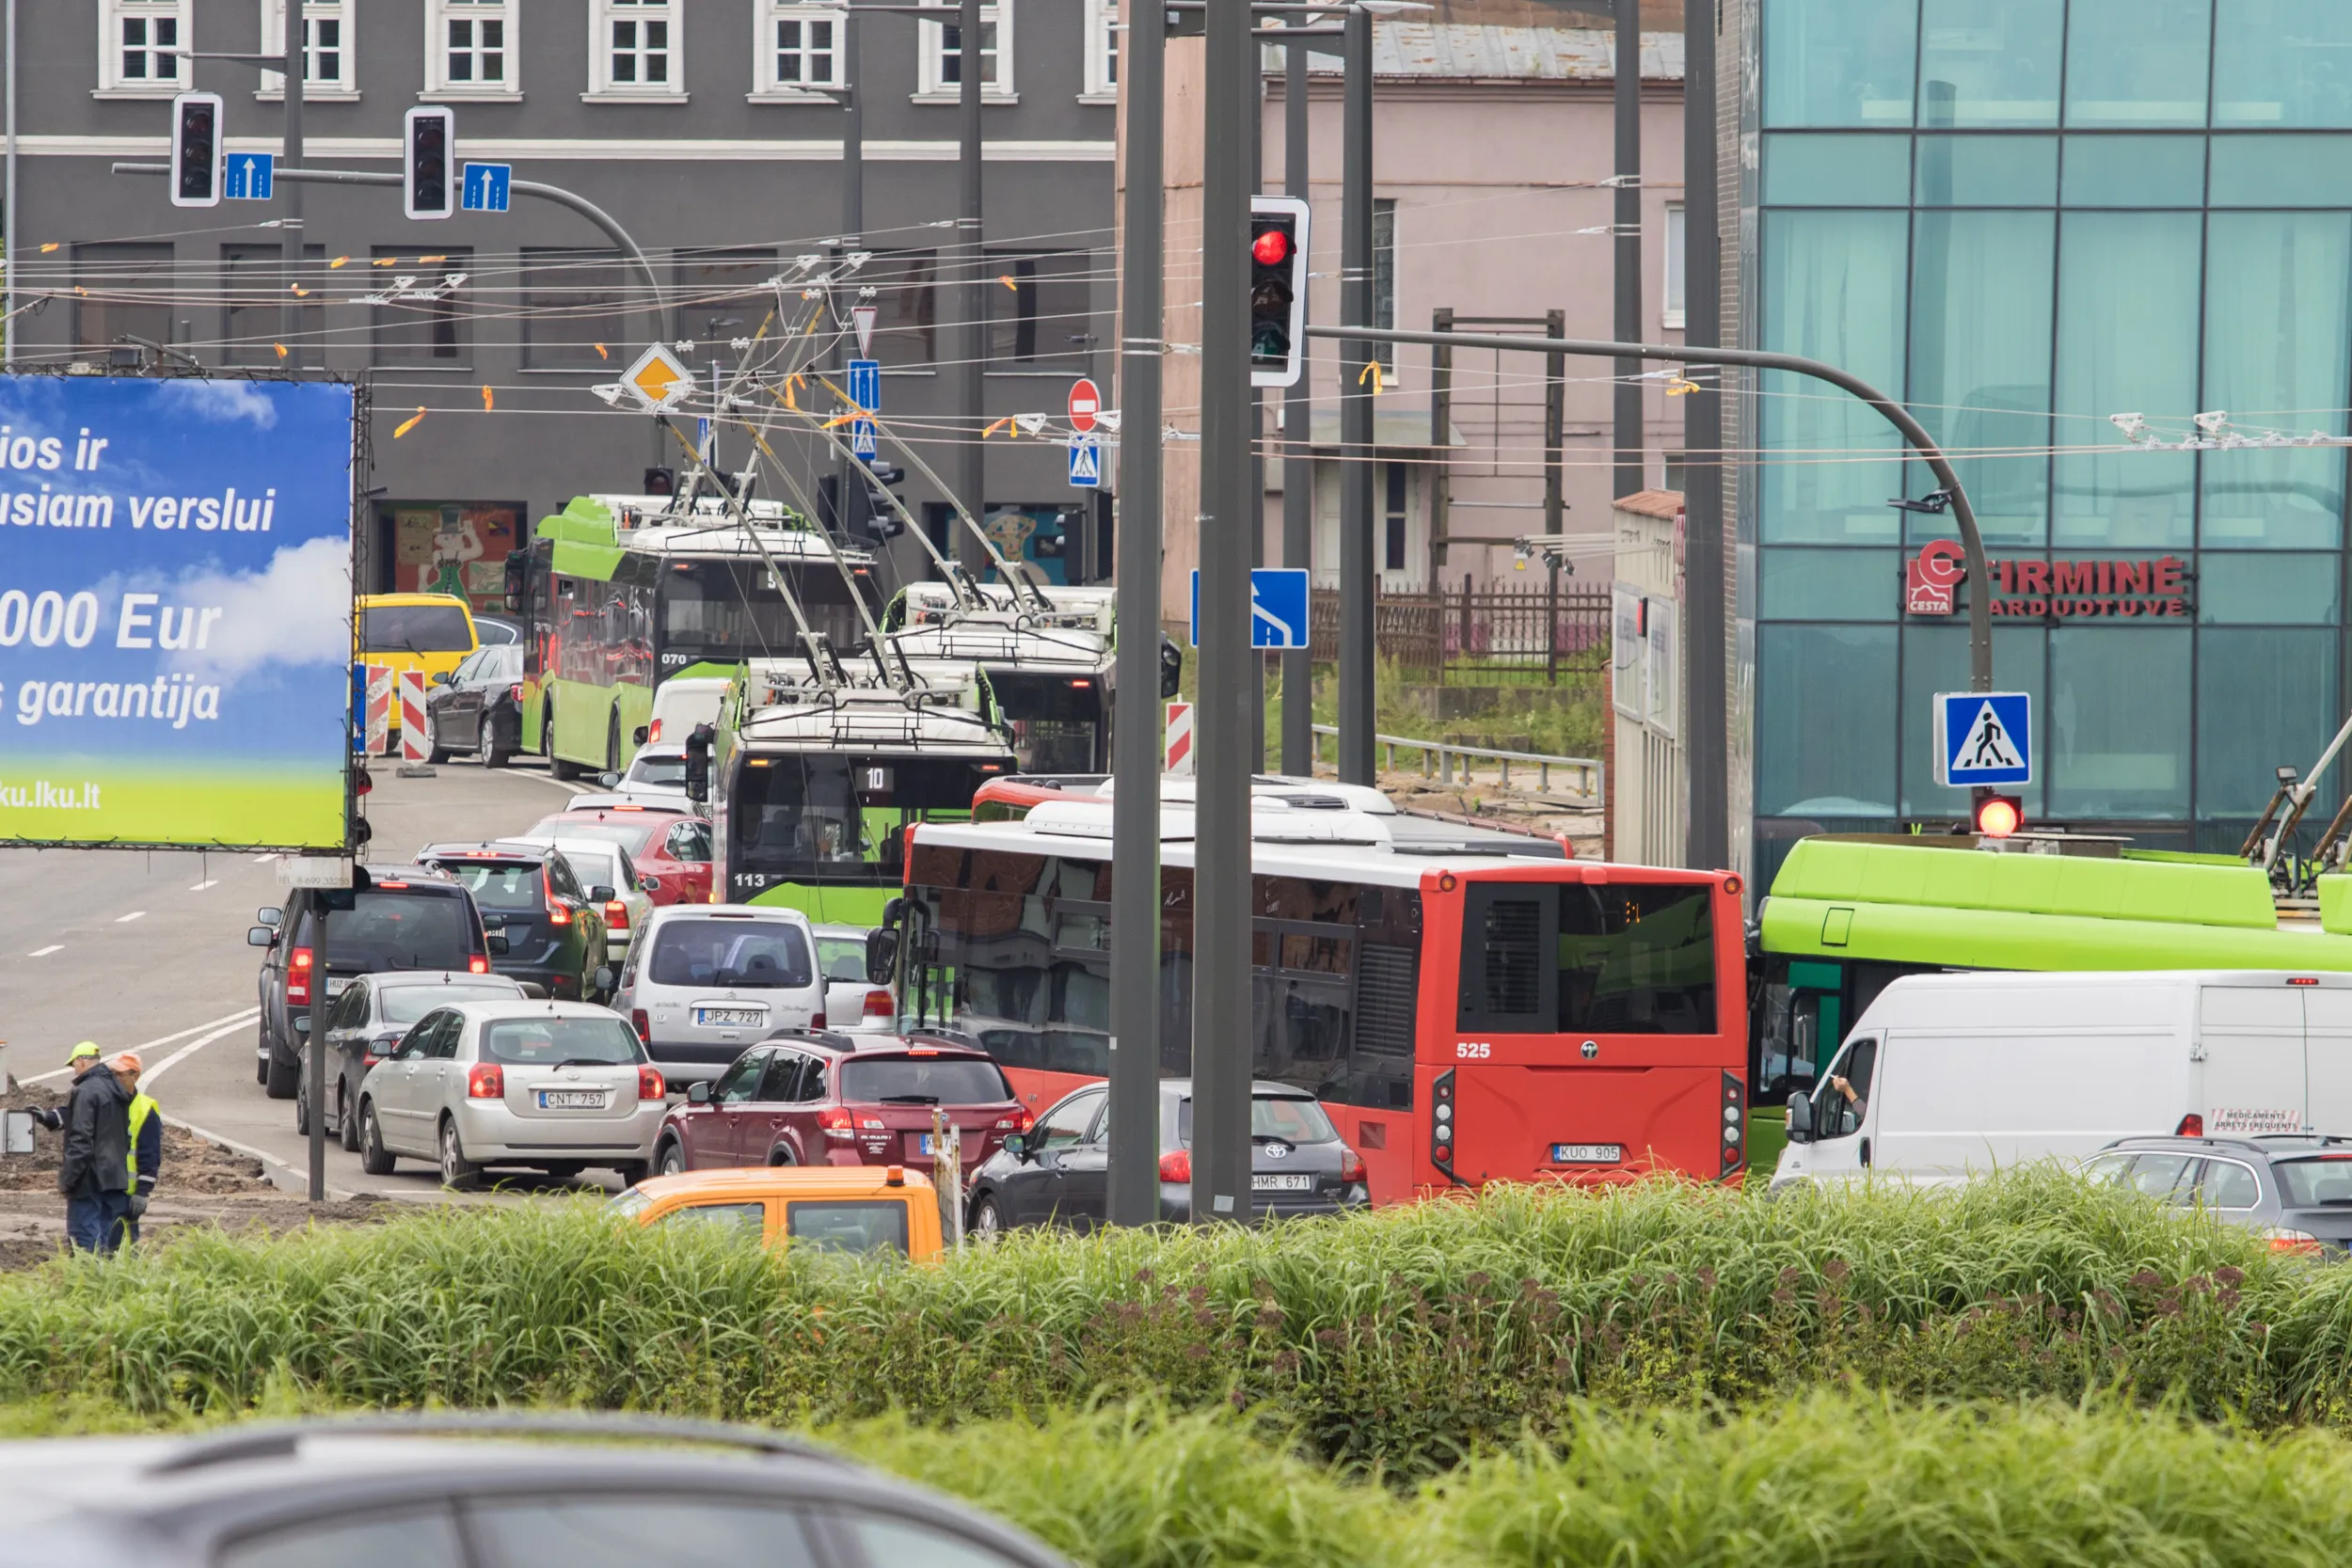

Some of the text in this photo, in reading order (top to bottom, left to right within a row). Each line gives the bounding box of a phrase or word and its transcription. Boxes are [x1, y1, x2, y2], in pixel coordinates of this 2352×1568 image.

[74, 427, 108, 470] ir
[129, 487, 276, 531] verslui
[1909, 601, 1949, 611] CESTA
[0, 590, 222, 650] 000 Eur
[661, 653, 687, 665] 070
[16, 673, 220, 730] garantija
[866, 767, 883, 790] 10
[735, 873, 765, 887] 113
[707, 1010, 760, 1022] JPZ 727
[1456, 1042, 1491, 1059] 525
[548, 1093, 603, 1105] CNT 757
[1561, 1147, 1618, 1159] KUO 905
[1252, 1176, 1307, 1188] HMR 671
